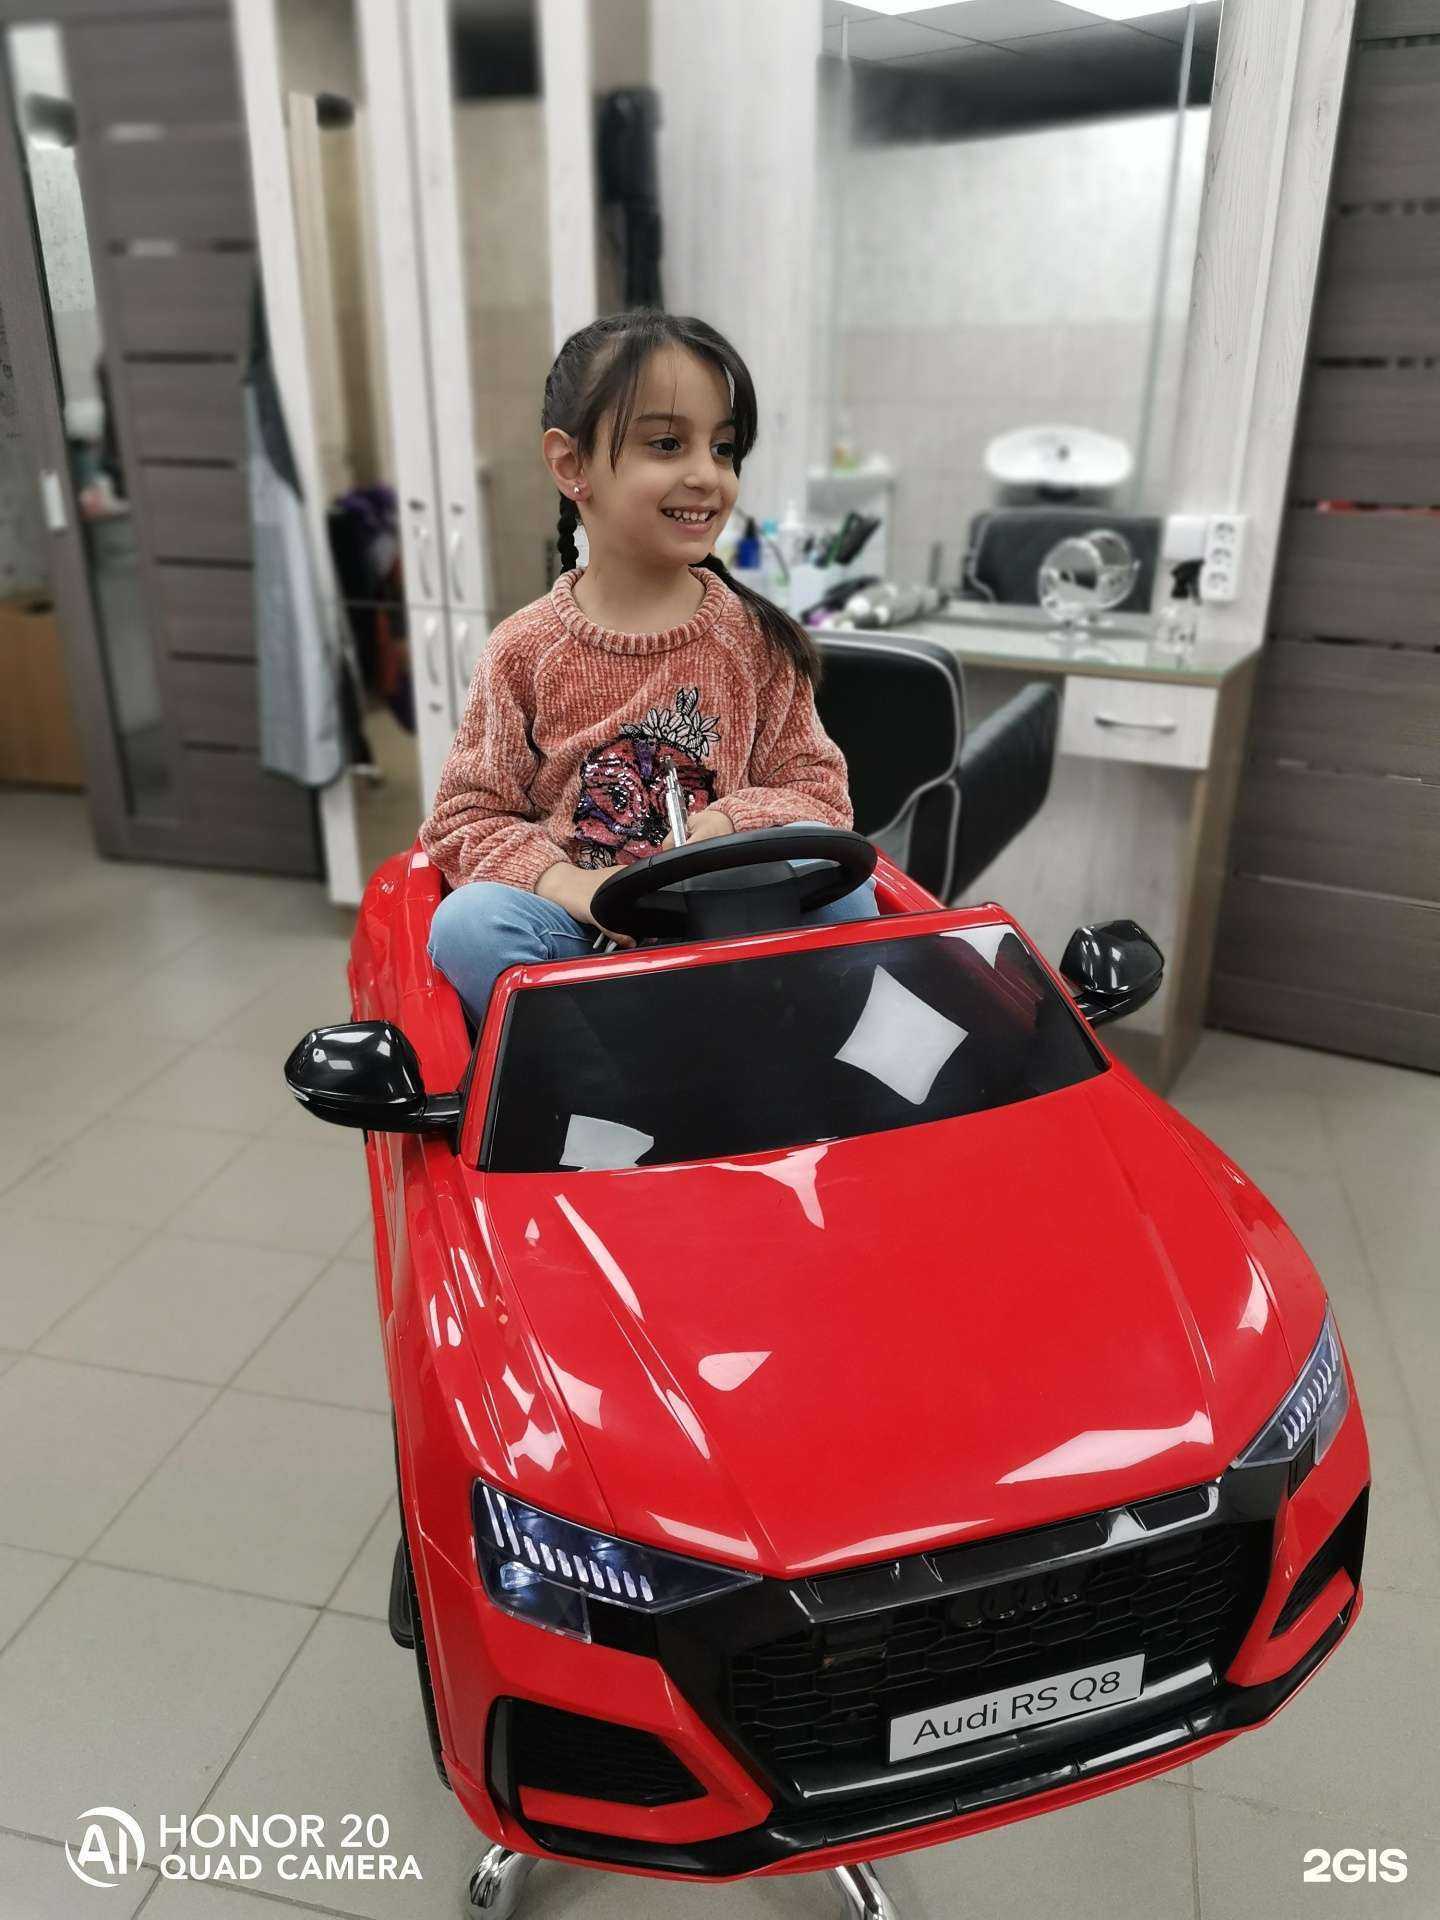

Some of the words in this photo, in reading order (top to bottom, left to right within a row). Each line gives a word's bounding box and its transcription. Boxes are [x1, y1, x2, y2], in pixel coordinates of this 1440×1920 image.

[913, 1702, 998, 1746] Audi
[1011, 1686, 1058, 1720] RS
[1069, 1671, 1121, 1702] Q8
